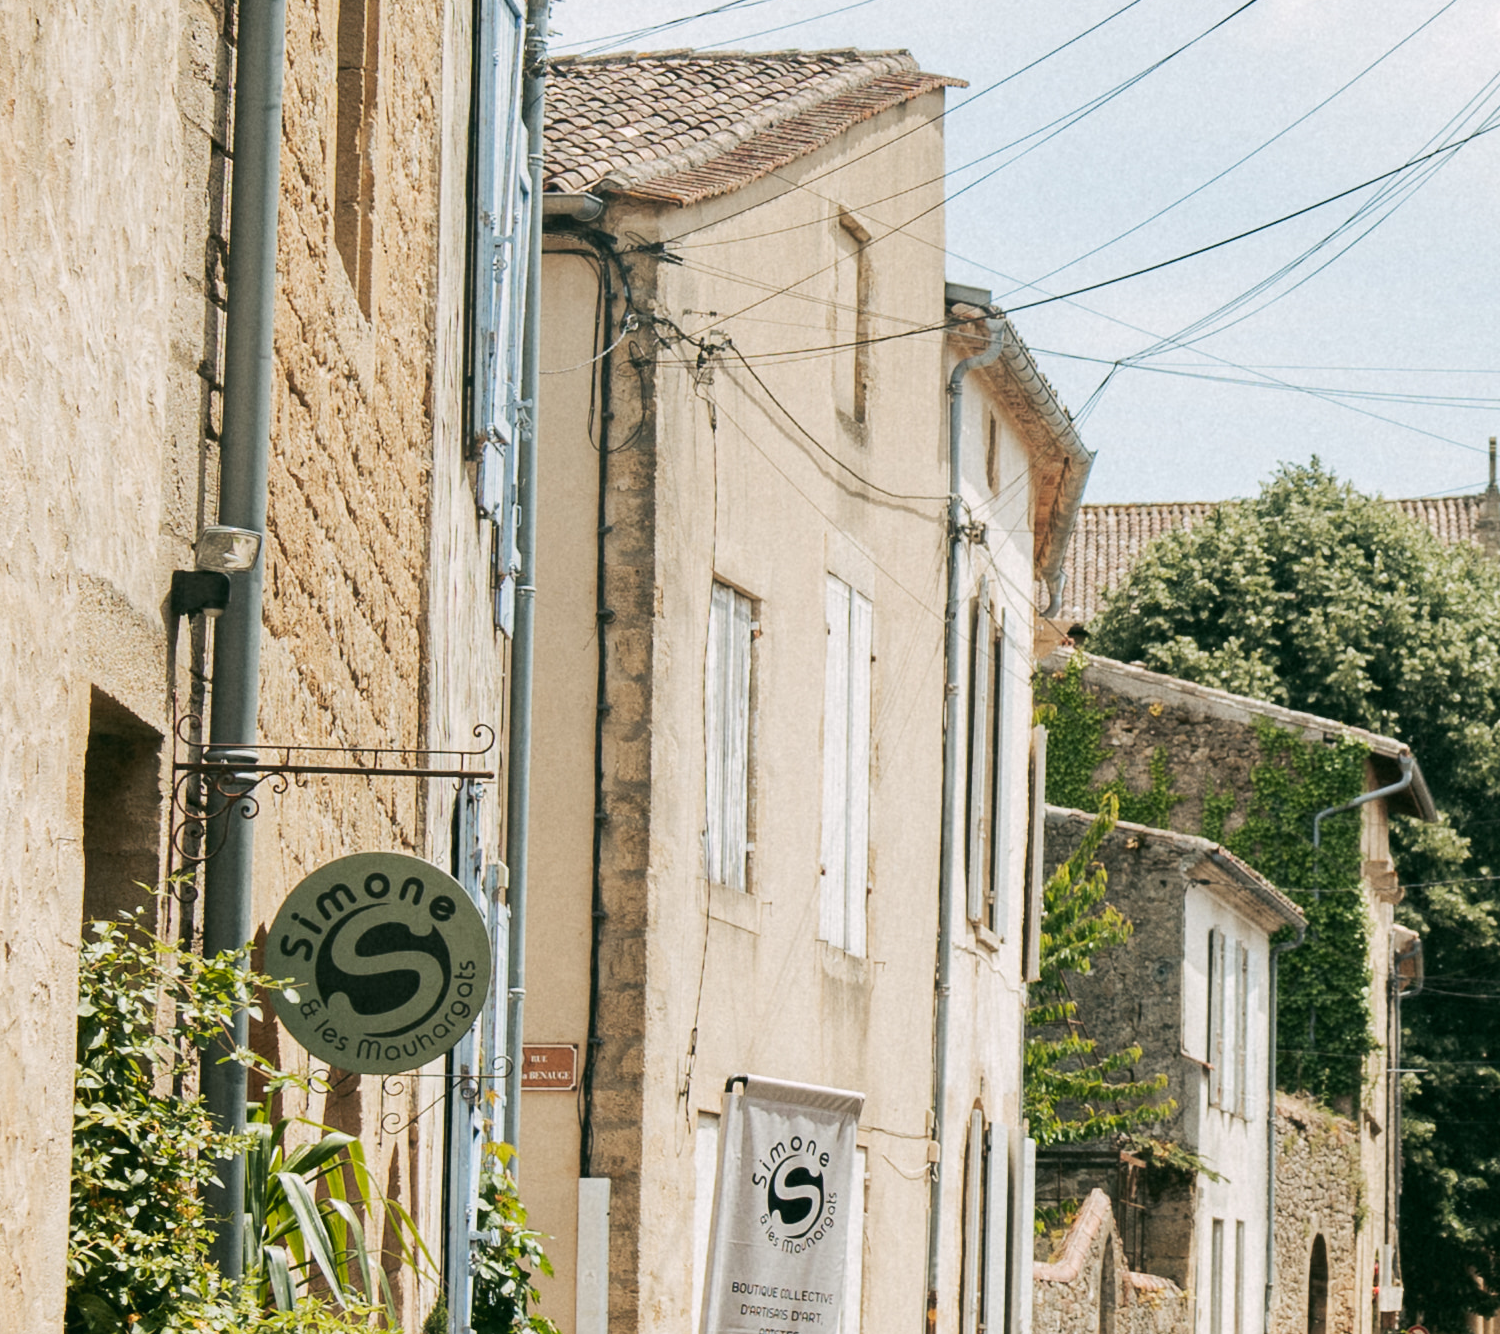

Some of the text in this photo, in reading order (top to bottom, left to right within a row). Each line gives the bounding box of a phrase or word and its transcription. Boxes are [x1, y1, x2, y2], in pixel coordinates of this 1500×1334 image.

[280, 872, 456, 962] Simone
[300, 960, 476, 1061] & les Mauhargats
[531, 1055, 548, 1063] RUE
[529, 1070, 571, 1080] BENAUGE
[752, 1136, 830, 1189] Simone
[765, 1225, 780, 1247] les
[731, 1281, 834, 1305] BOUTIQUE COLLECTIVE
[791, 1310, 823, 1326] D'ART,
